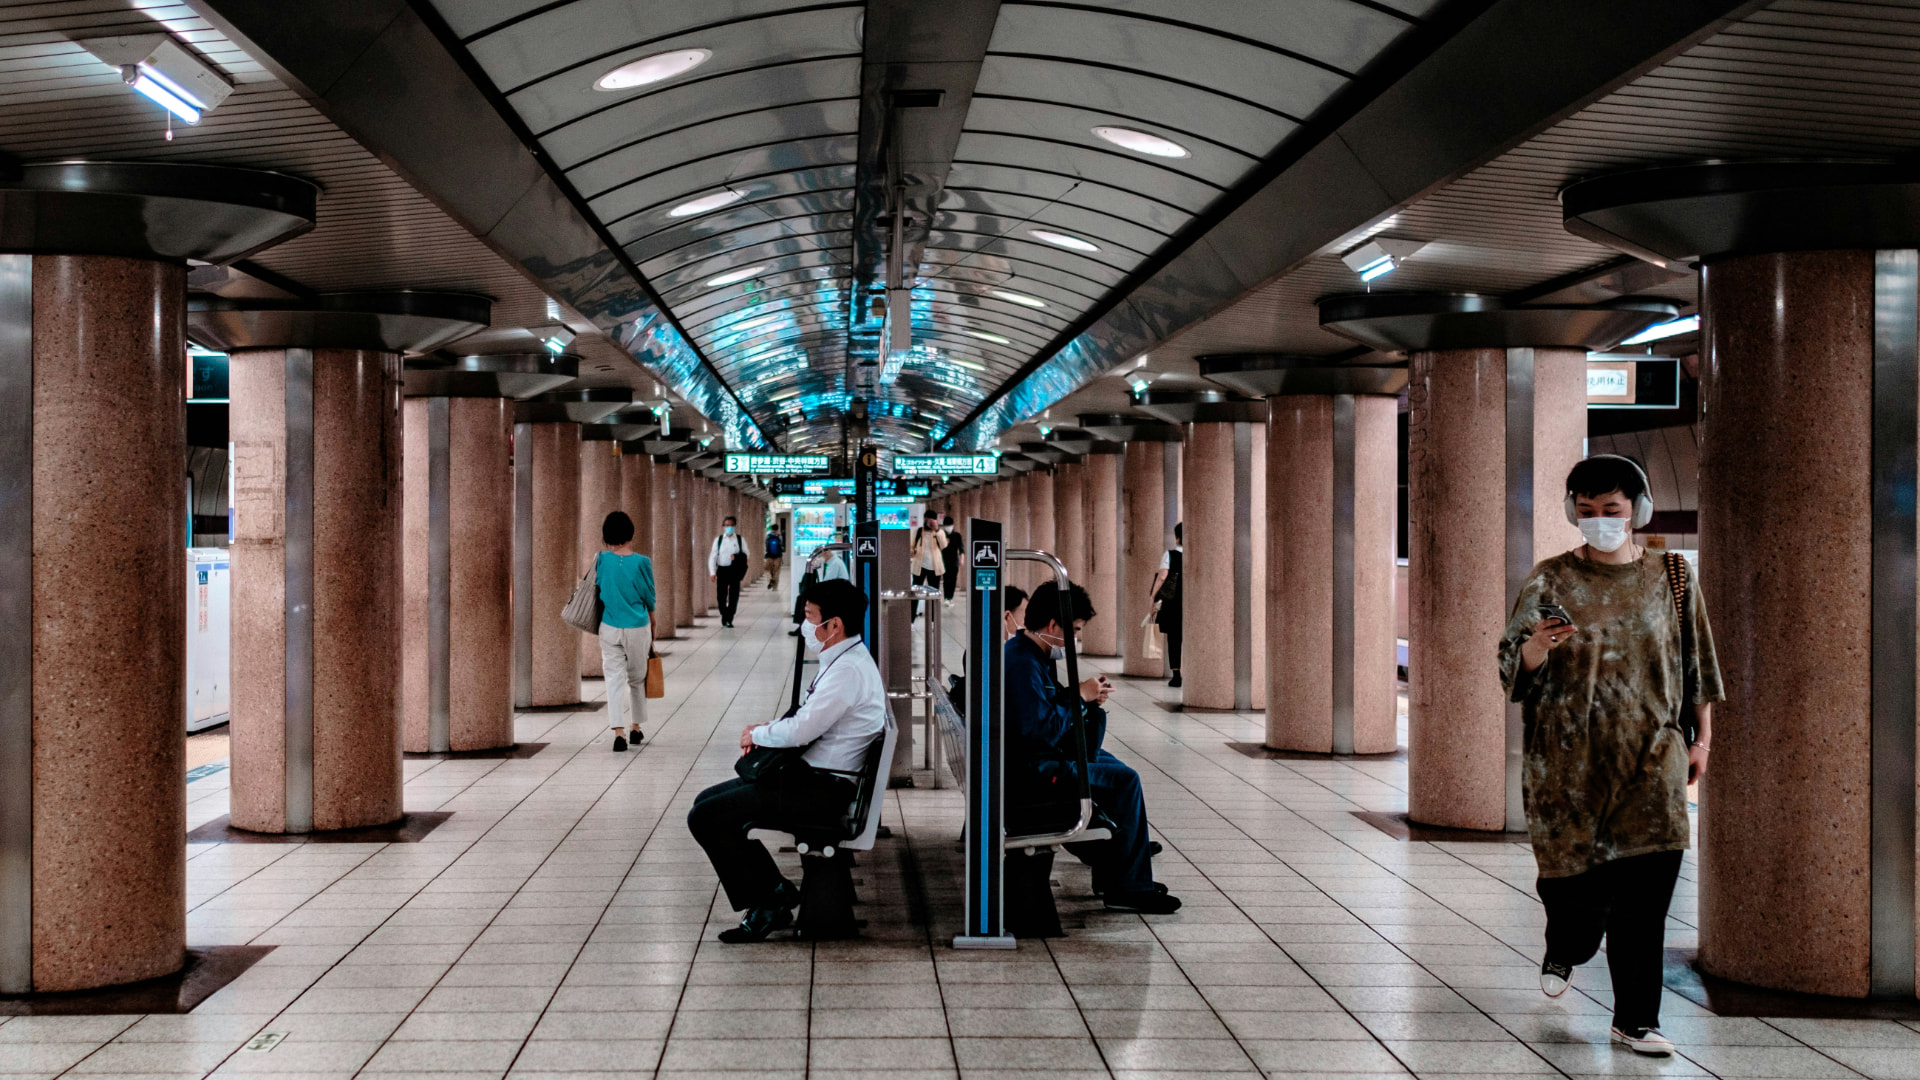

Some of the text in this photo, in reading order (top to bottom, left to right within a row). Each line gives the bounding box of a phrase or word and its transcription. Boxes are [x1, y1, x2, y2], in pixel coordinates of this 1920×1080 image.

[729, 457, 739, 471] 3
[975, 458, 985, 472] 4
[775, 482, 783, 493] 3
